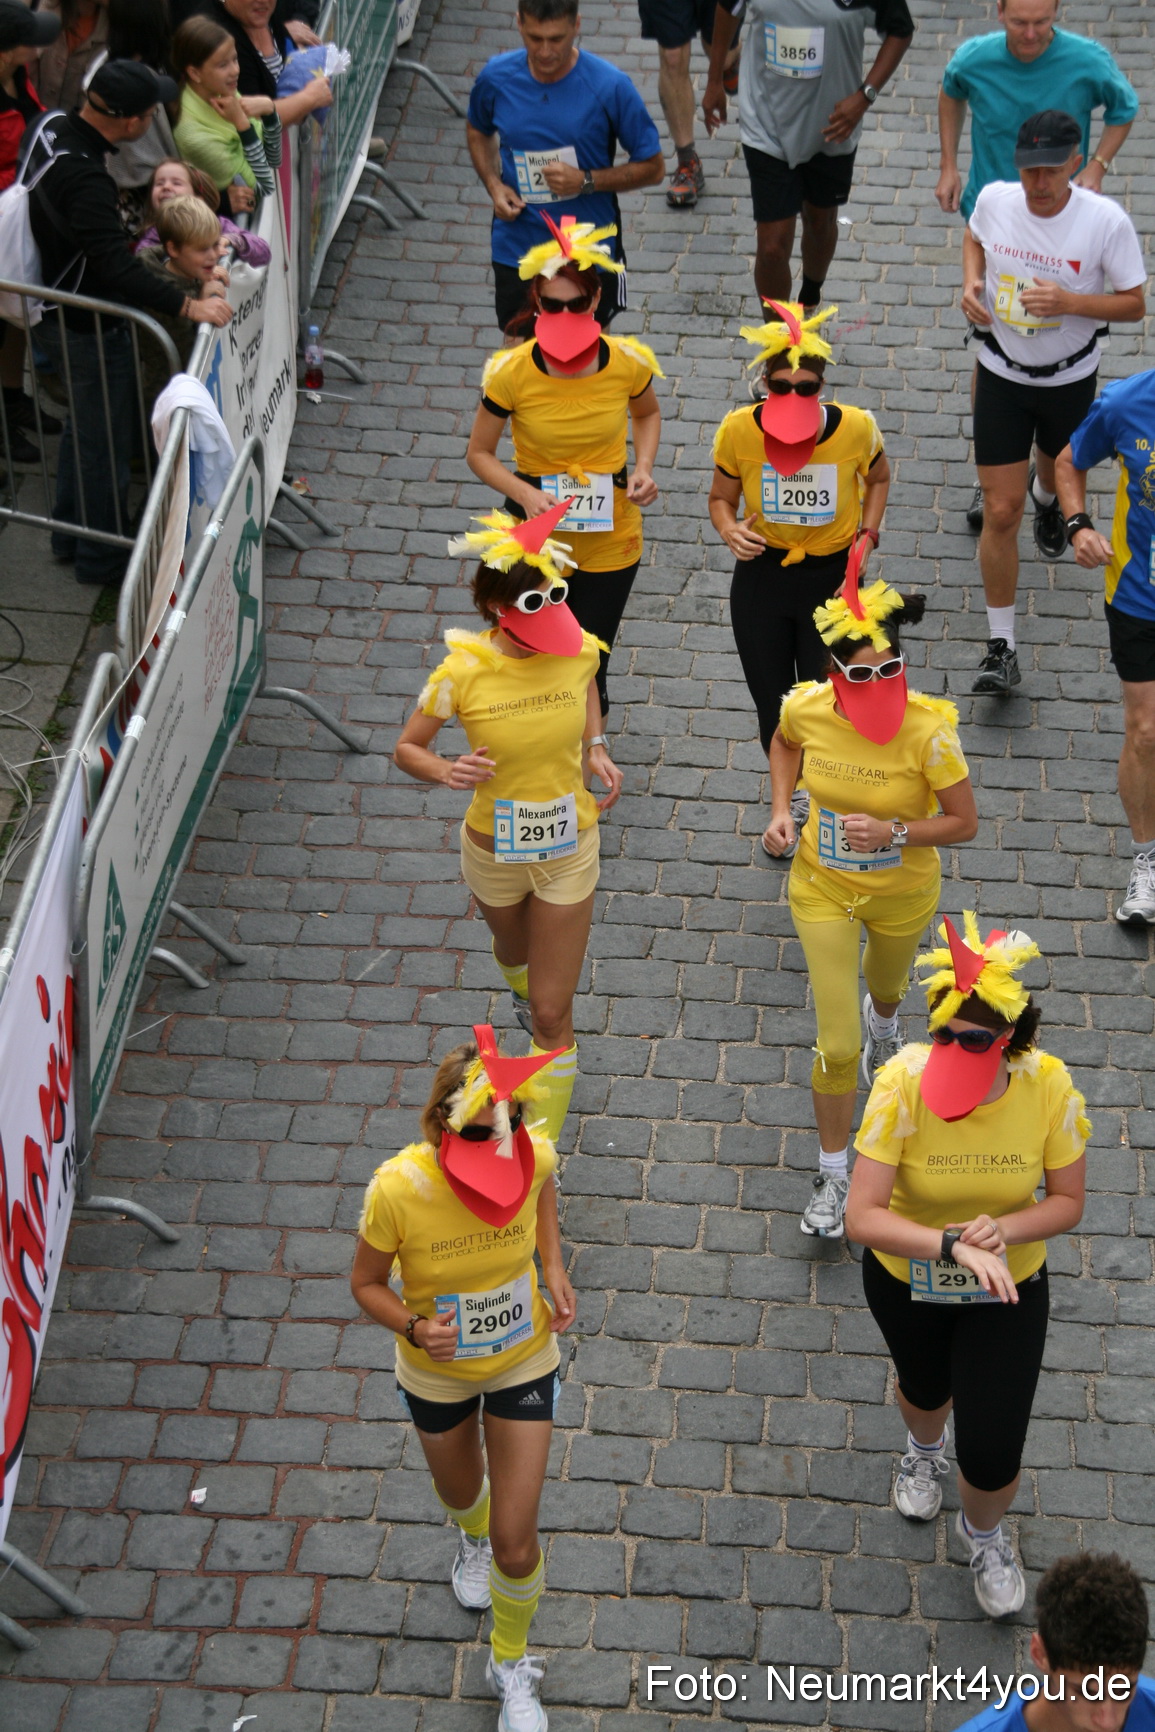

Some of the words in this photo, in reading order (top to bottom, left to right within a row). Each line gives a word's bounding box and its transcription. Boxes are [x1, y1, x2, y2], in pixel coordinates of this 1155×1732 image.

[780, 45, 816, 60] 3856
[993, 244, 1063, 268] SCHULTHEISS
[1135, 438, 1151, 451] 10.
[564, 494, 606, 511] 2717
[783, 489, 830, 507] 2093
[488, 691, 577, 714] BRIGITTEKARL
[809, 756, 889, 780] BRIGITTEKARL
[518, 805, 567, 819] Alexandra
[520, 820, 568, 841] 2917
[927, 1154, 1027, 1167] BRIGITTEKARL
[431, 1224, 527, 1254] BRIGITTEKARL
[938, 1273, 980, 1287] 291
[465, 1291, 511, 1313] Siglinde
[469, 1303, 523, 1334] 2900
